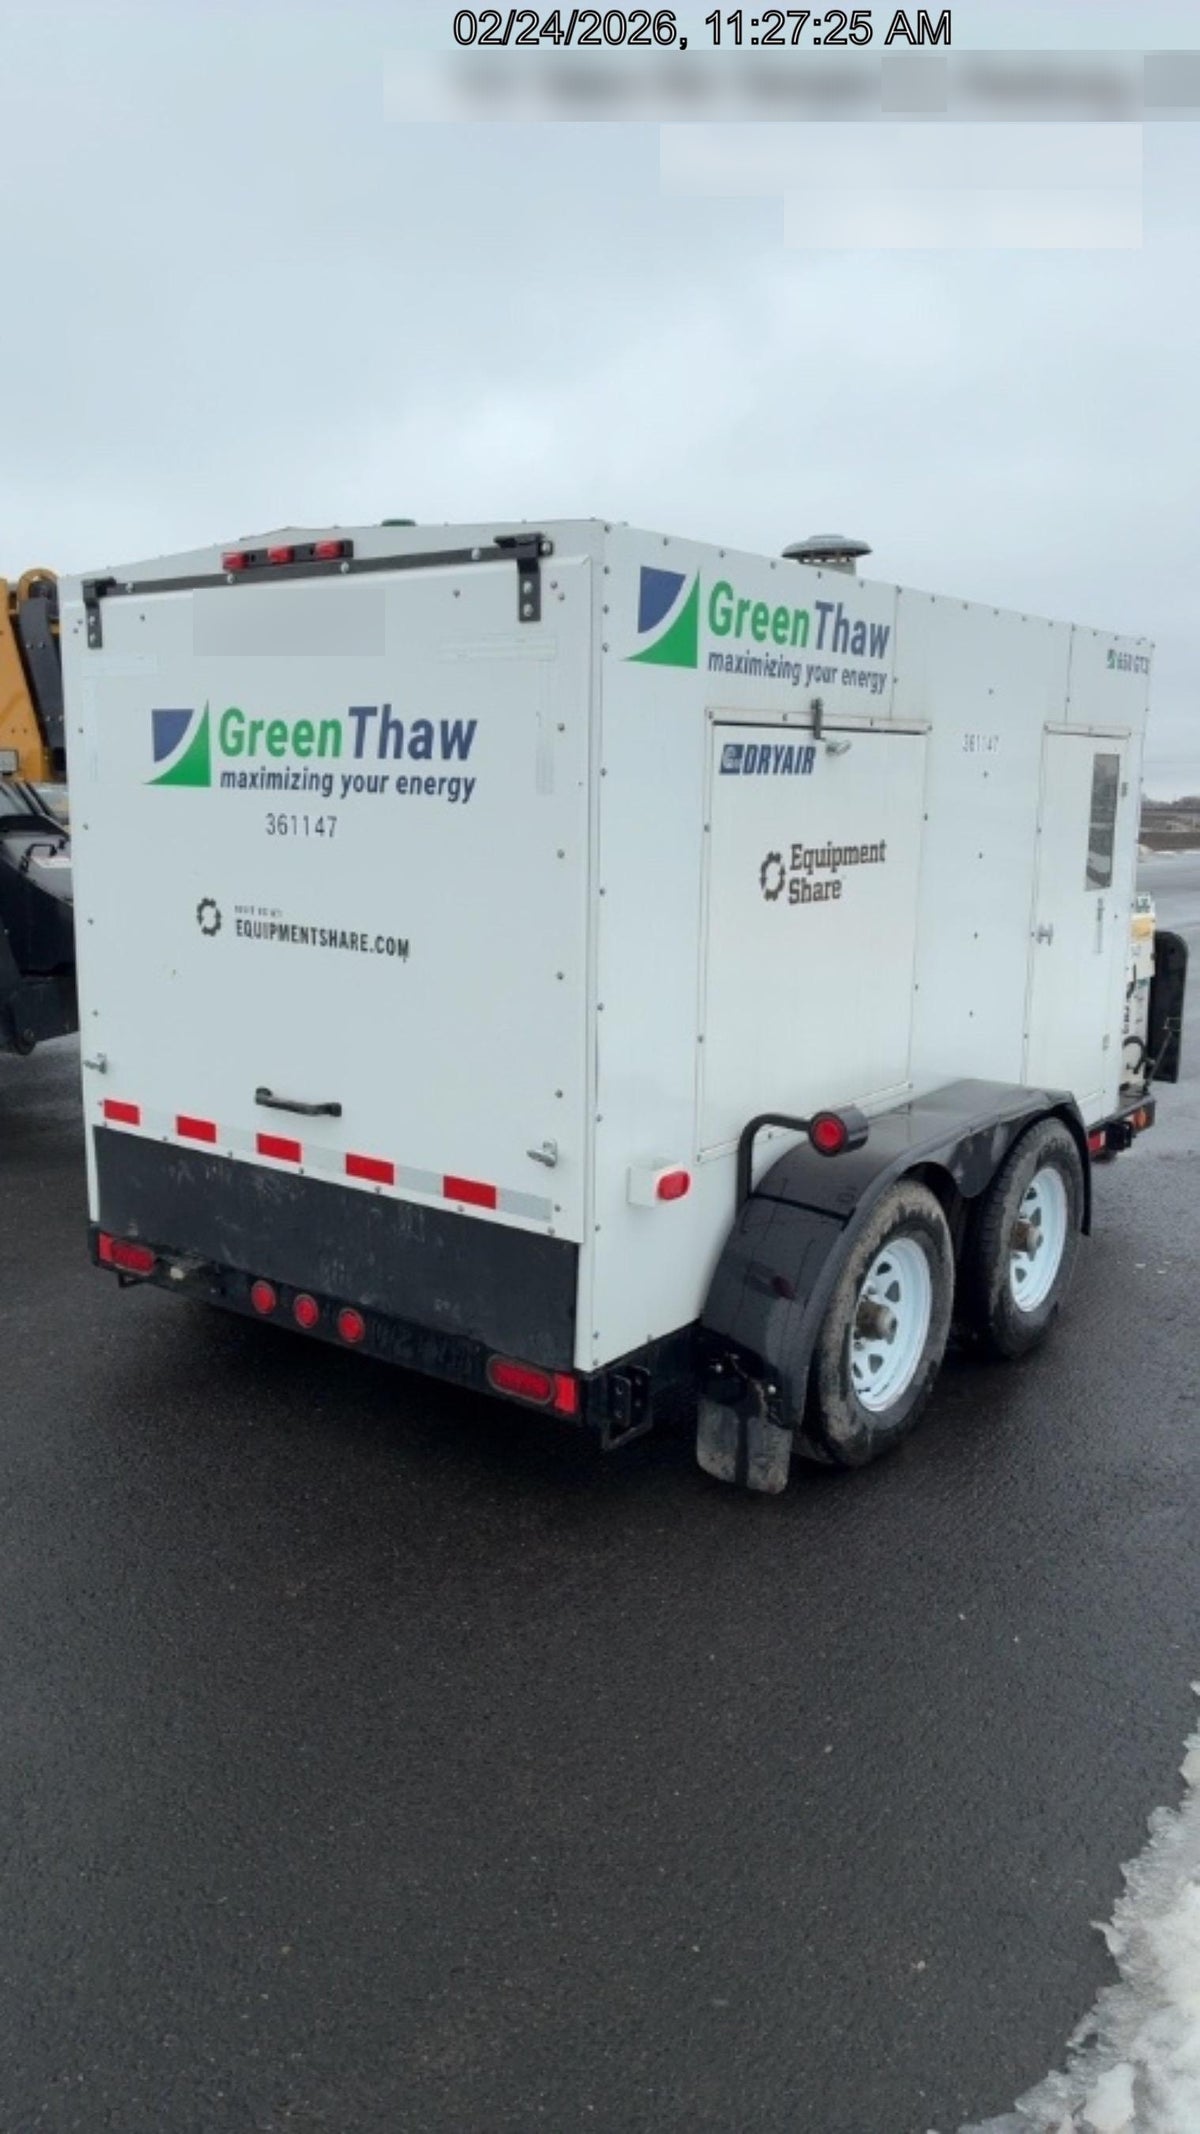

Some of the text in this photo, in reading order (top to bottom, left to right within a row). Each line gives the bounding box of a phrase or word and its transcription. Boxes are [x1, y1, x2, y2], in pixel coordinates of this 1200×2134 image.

[708, 650, 888, 695] maximizing your energy
[742, 744, 817, 775] DRYAIR
[220, 766, 476, 804] maximizing your energy
[264, 813, 338, 838] 361147
[790, 839, 887, 875] Equipment
[788, 877, 842, 906] Share
[236, 919, 409, 958] EQUIPMENTSHARE.COM
